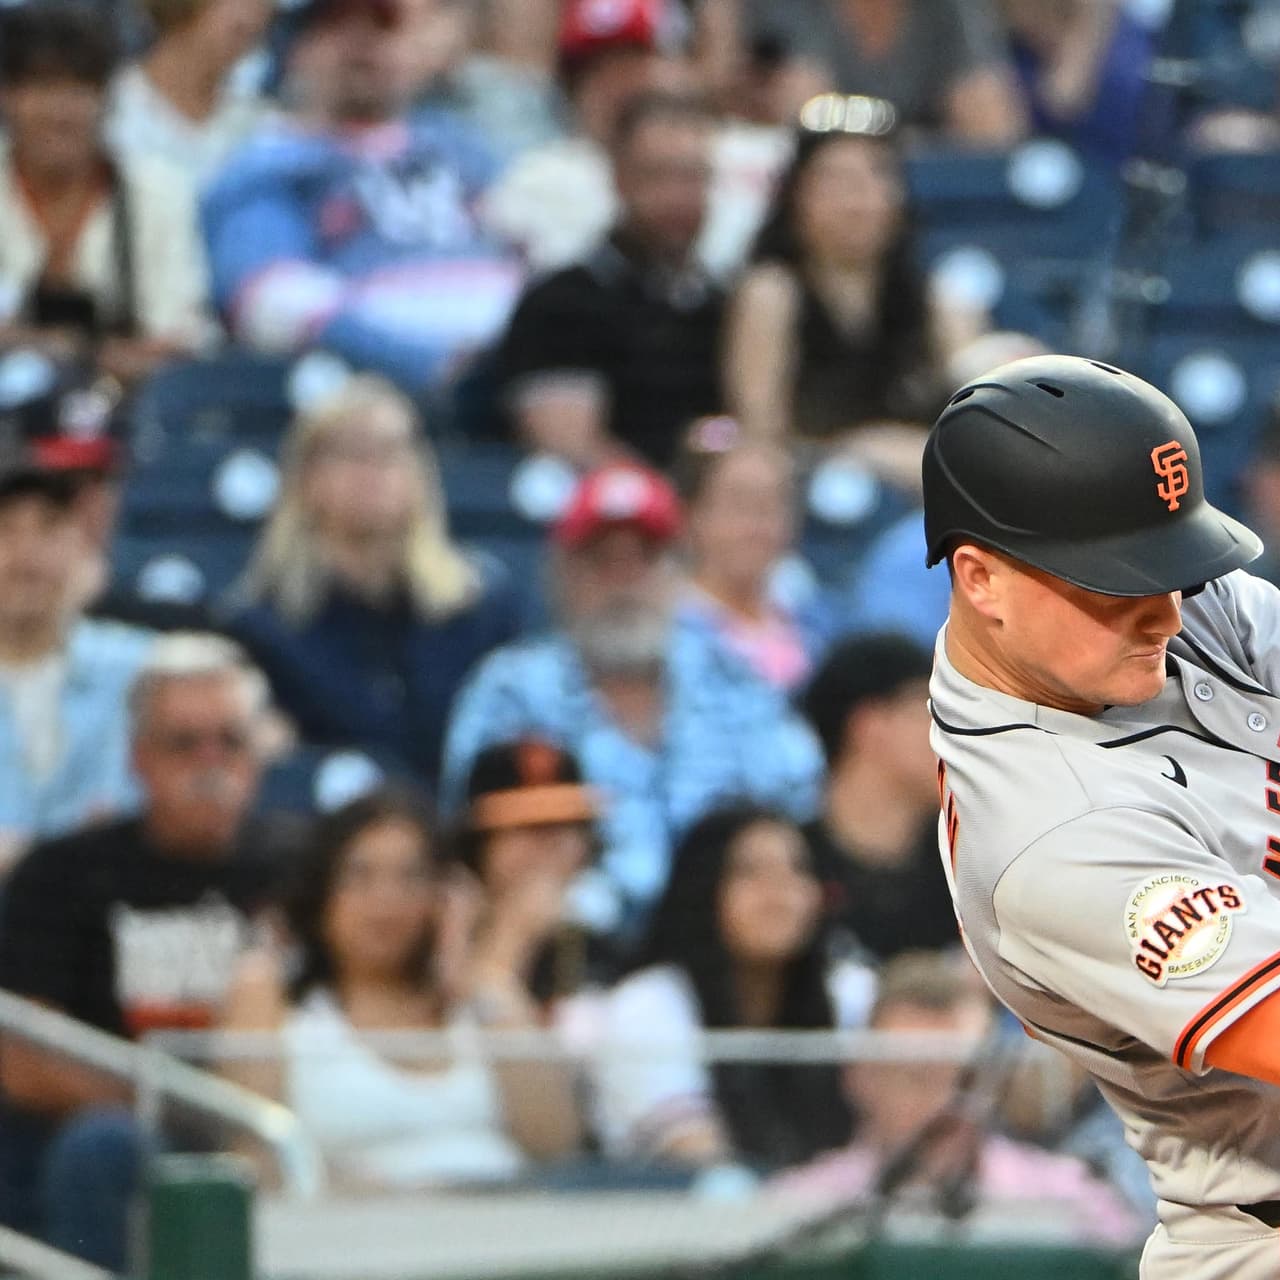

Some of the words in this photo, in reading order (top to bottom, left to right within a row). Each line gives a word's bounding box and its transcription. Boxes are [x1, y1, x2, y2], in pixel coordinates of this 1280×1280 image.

[1150, 440, 1190, 512] SF
[1131, 874, 1200, 908] FRANCISCO
[1128, 911, 1140, 939] SAN
[1134, 884, 1243, 981] GIANTS
[1168, 947, 1221, 975] BASEBALL
[1215, 914, 1229, 944] CLUB
